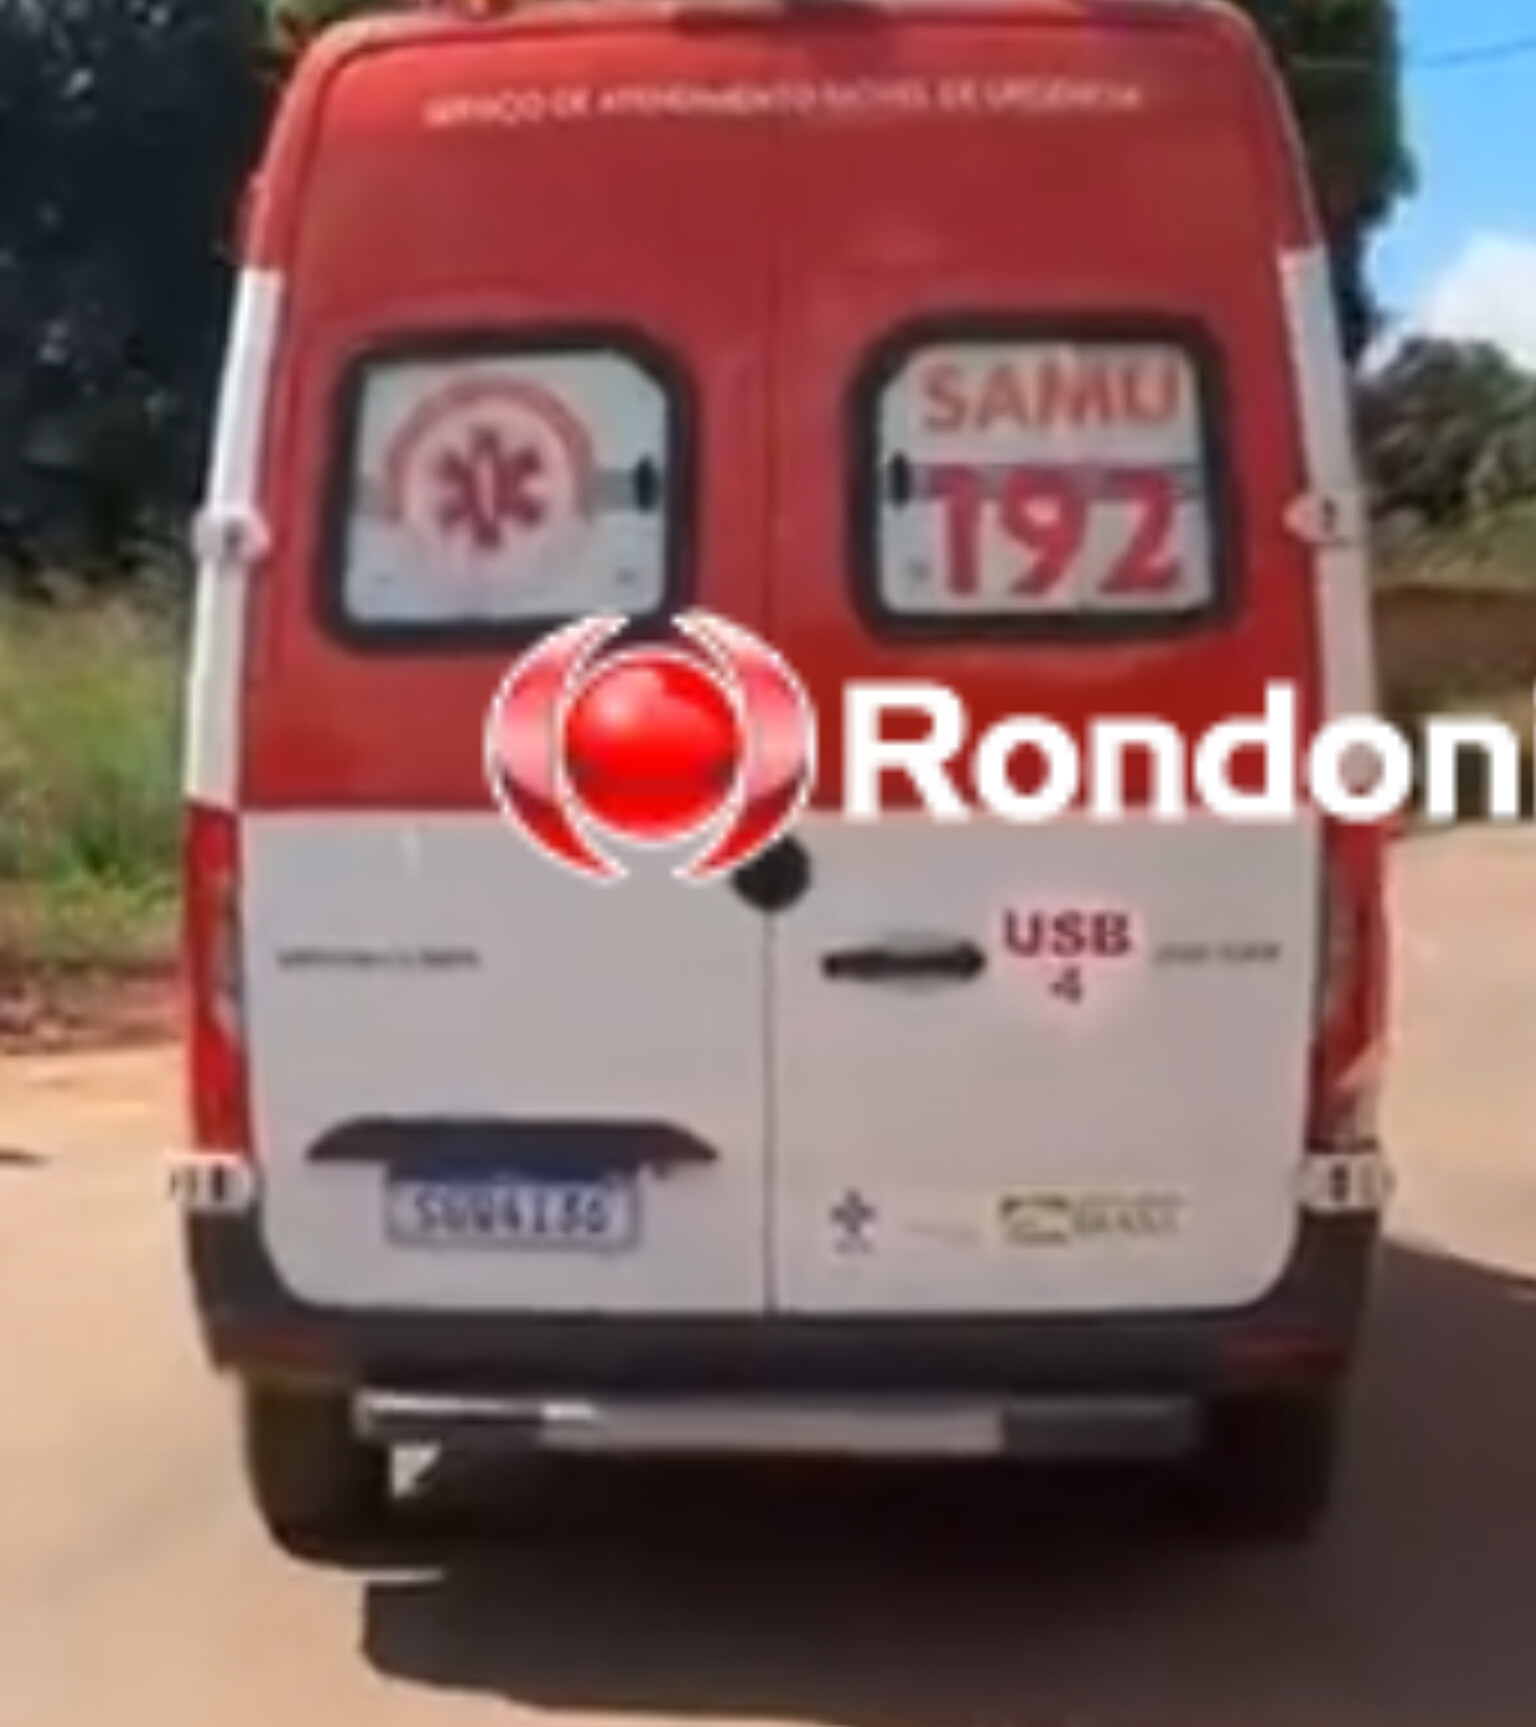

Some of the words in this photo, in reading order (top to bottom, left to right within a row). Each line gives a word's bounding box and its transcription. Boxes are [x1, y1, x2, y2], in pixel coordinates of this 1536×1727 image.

[920, 358, 1180, 432] SAMU
[926, 463, 1184, 598] 192
[1002, 910, 1133, 960] USB
[1050, 967, 1083, 1003] 4
